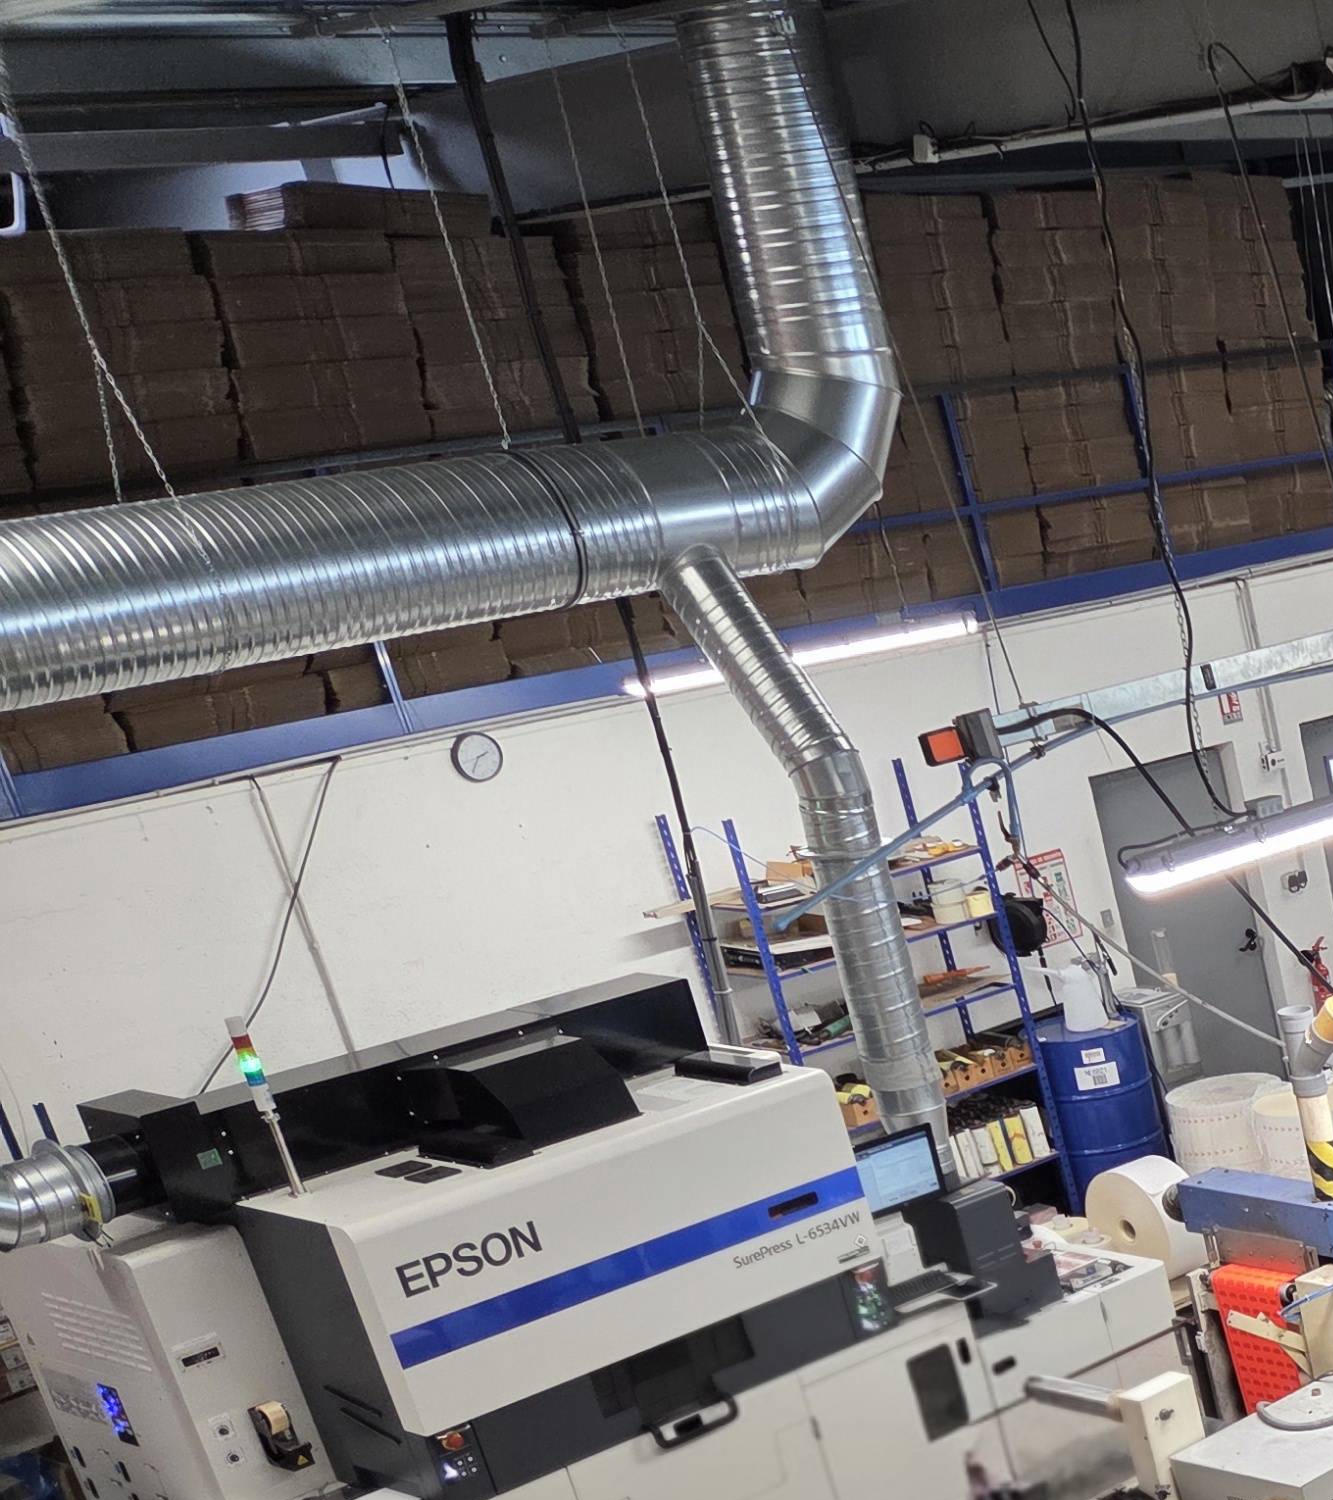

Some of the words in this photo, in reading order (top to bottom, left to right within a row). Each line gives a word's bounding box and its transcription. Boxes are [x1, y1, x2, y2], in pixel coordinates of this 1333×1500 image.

[395, 1220, 543, 1298] EPSON
[733, 1240, 793, 1269] SurePress
[795, 1211, 860, 1245] L-6534VW
